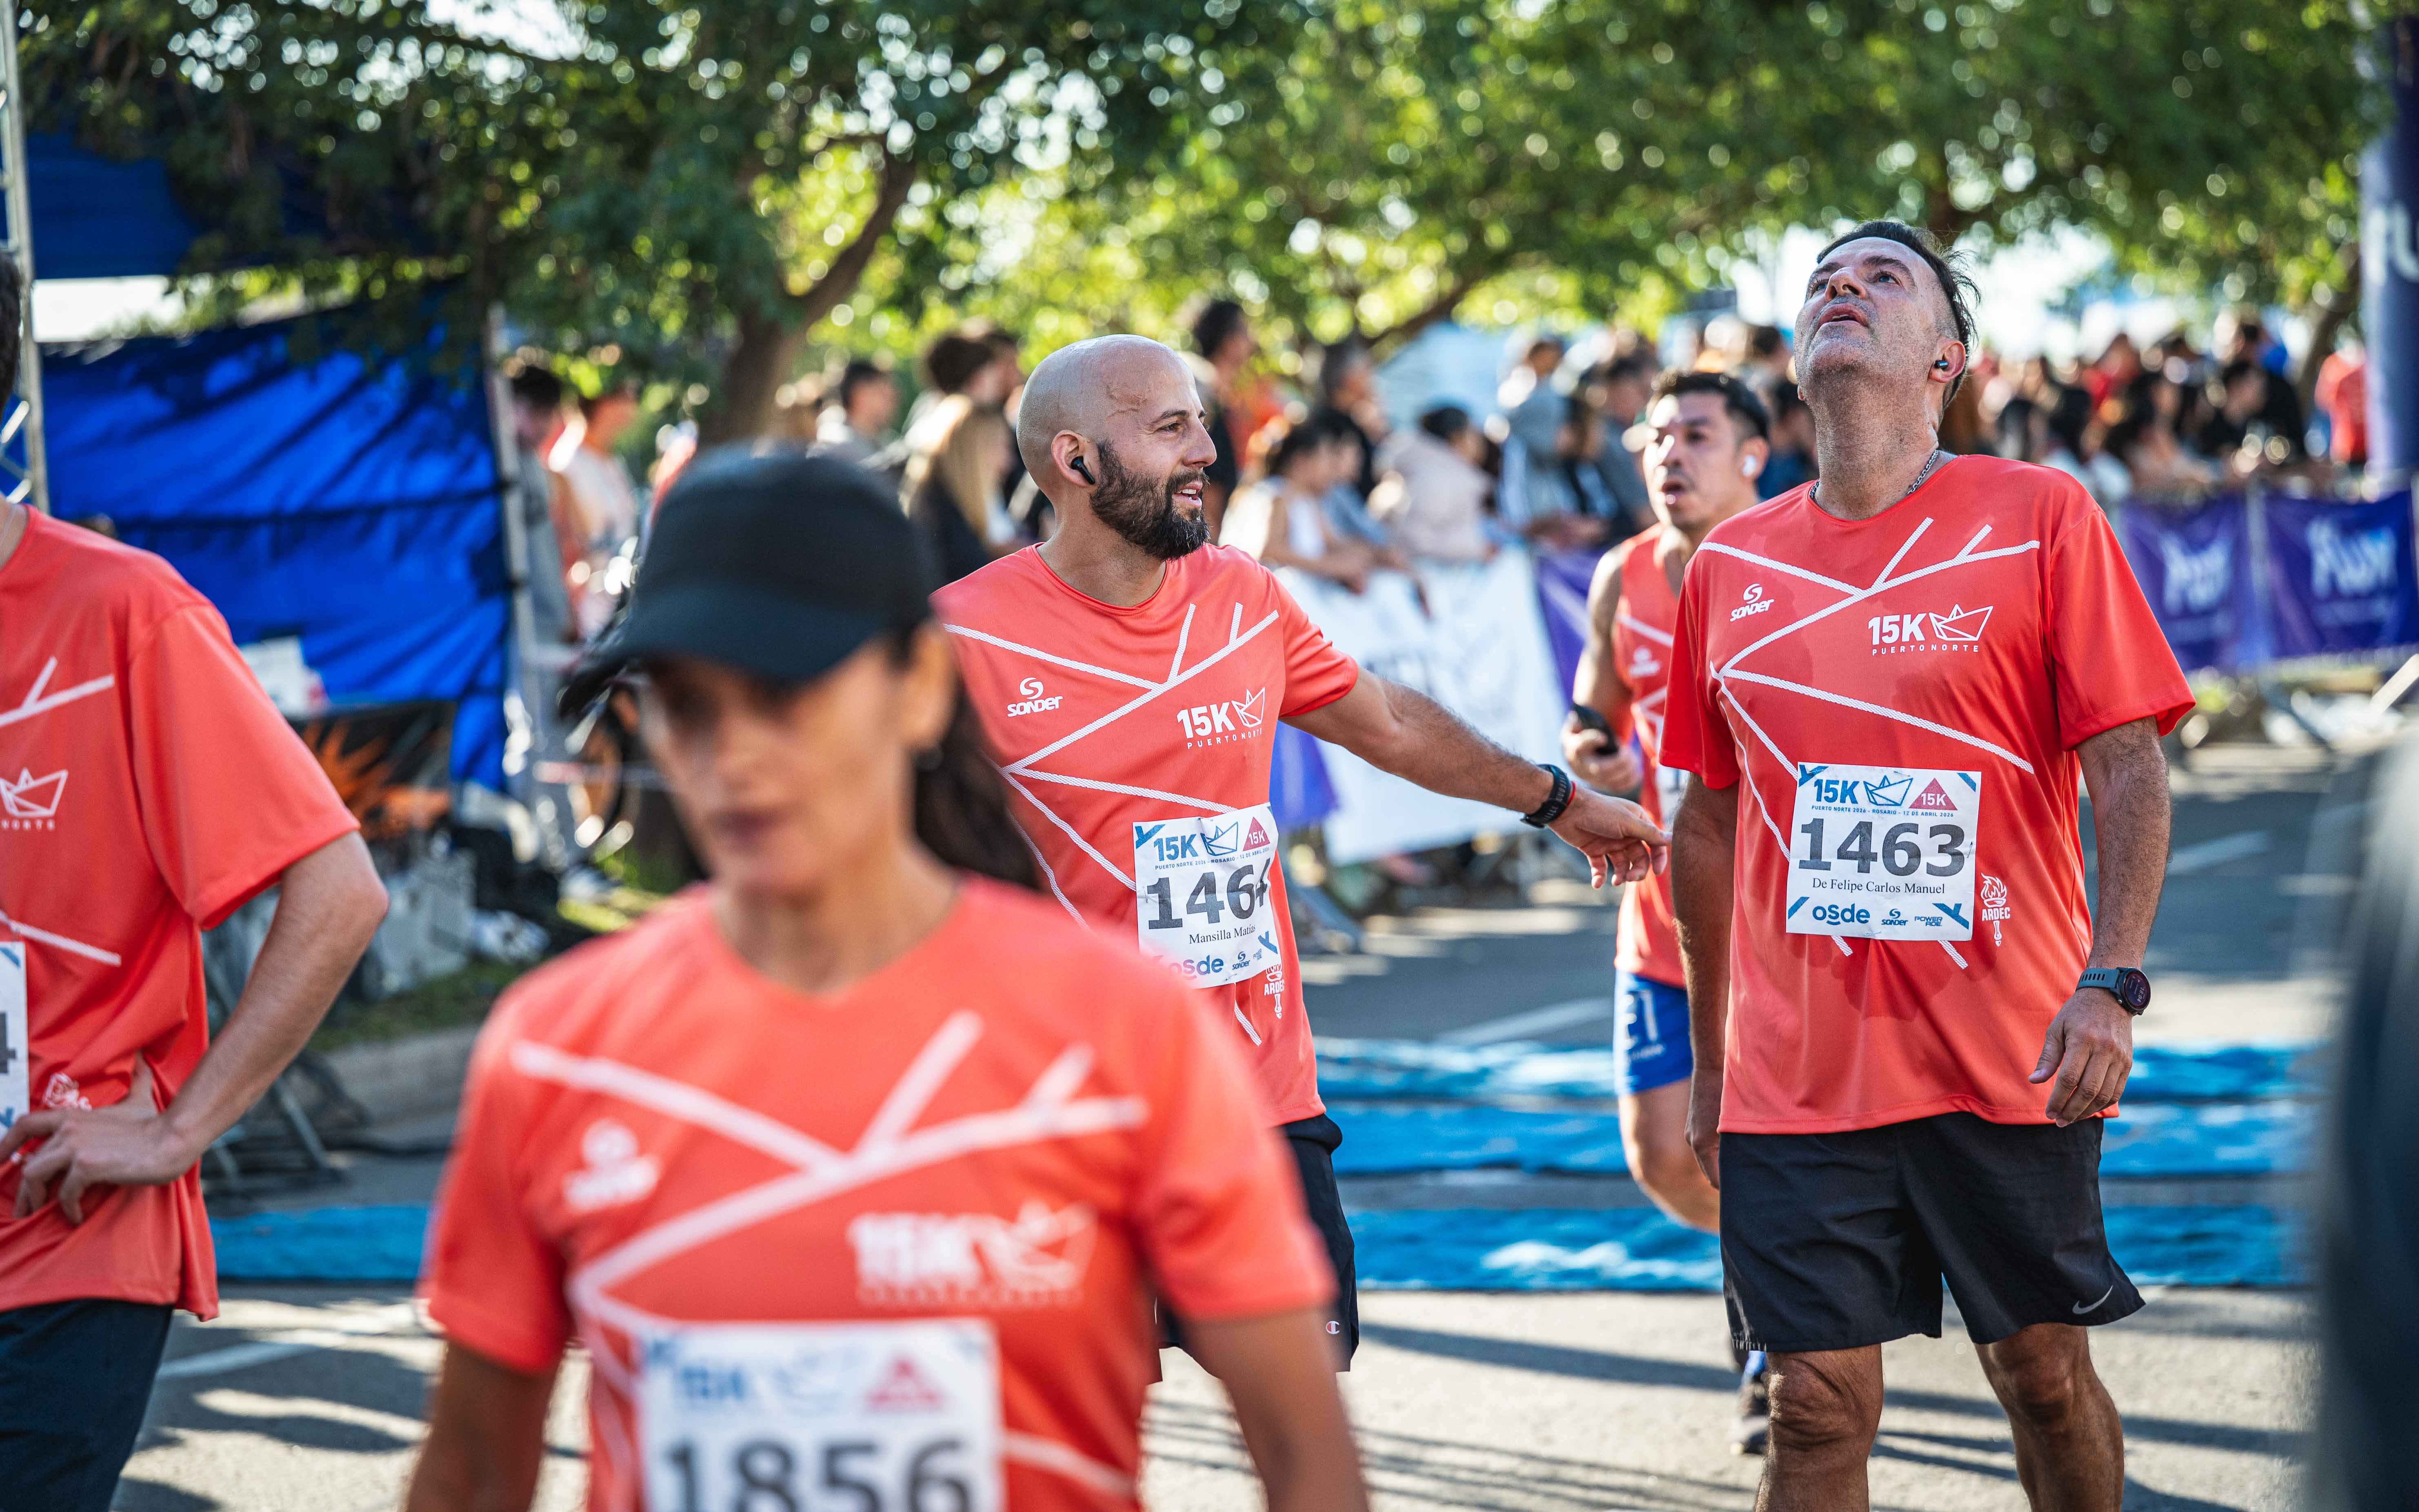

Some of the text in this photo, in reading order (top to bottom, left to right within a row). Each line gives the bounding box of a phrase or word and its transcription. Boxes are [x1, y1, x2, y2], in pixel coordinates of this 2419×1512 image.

[1868, 613, 1927, 645] 15K
[1176, 702, 1236, 739] 15K
[1814, 779, 1859, 804] 15K
[1921, 793, 1946, 806] 15K
[1153, 834, 1199, 861] 15K
[1247, 829, 1266, 846] 15K
[1799, 818, 1965, 877] 1463
[1147, 858, 1271, 929] 1464
[1813, 878, 1945, 894] De Felipe Carlos Manuel
[1812, 903, 1870, 925] osde
[1981, 907, 2010, 921] ARDEC
[1189, 930, 1231, 944] Mansilla
[662, 1437, 973, 1512] 1856
